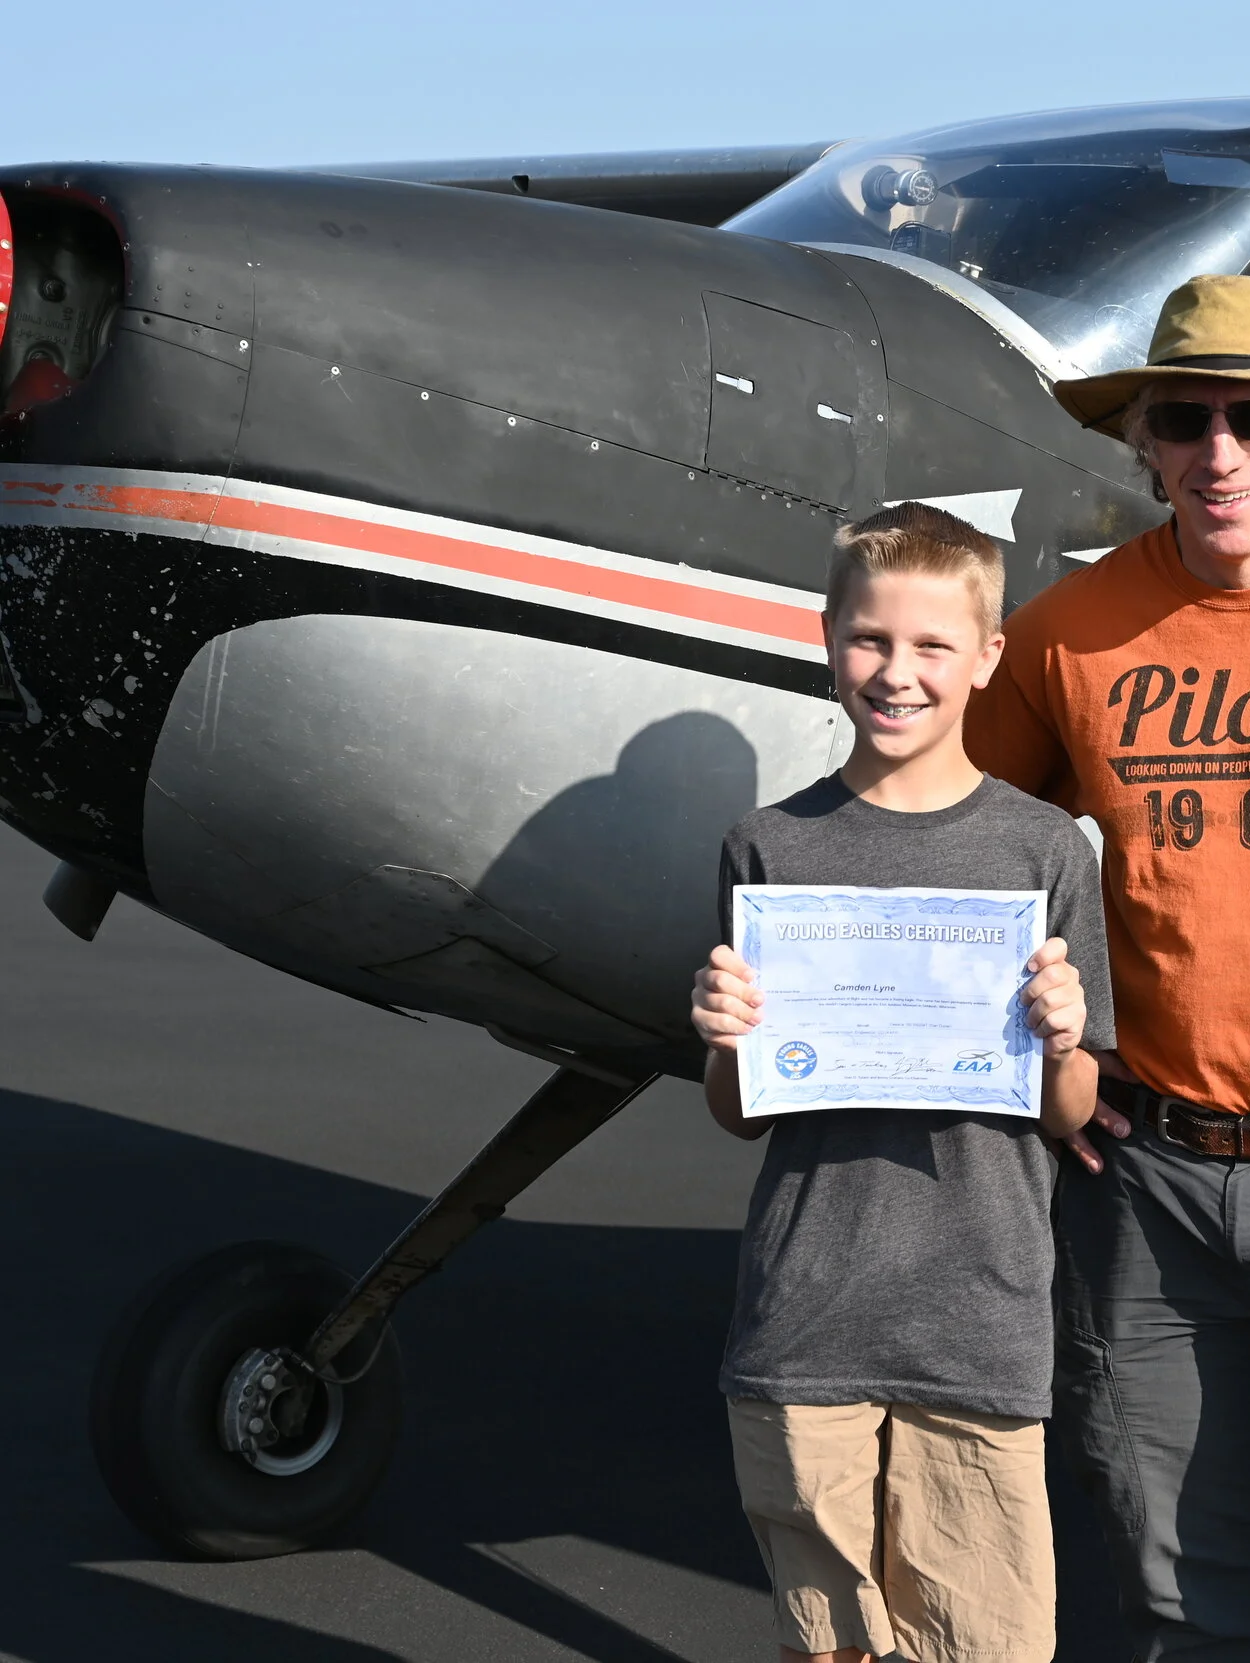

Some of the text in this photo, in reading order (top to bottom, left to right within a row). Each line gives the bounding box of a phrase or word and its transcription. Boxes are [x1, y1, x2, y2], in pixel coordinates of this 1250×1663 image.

[1125, 763, 1167, 777] LOOKING
[1169, 762, 1202, 775] DOWN
[1204, 761, 1220, 774] ON
[776, 923, 1005, 945] YOUNG EAGLES CERTIFICATE
[834, 983, 896, 993] Camden Lyne
[952, 1060, 993, 1073] EAA
